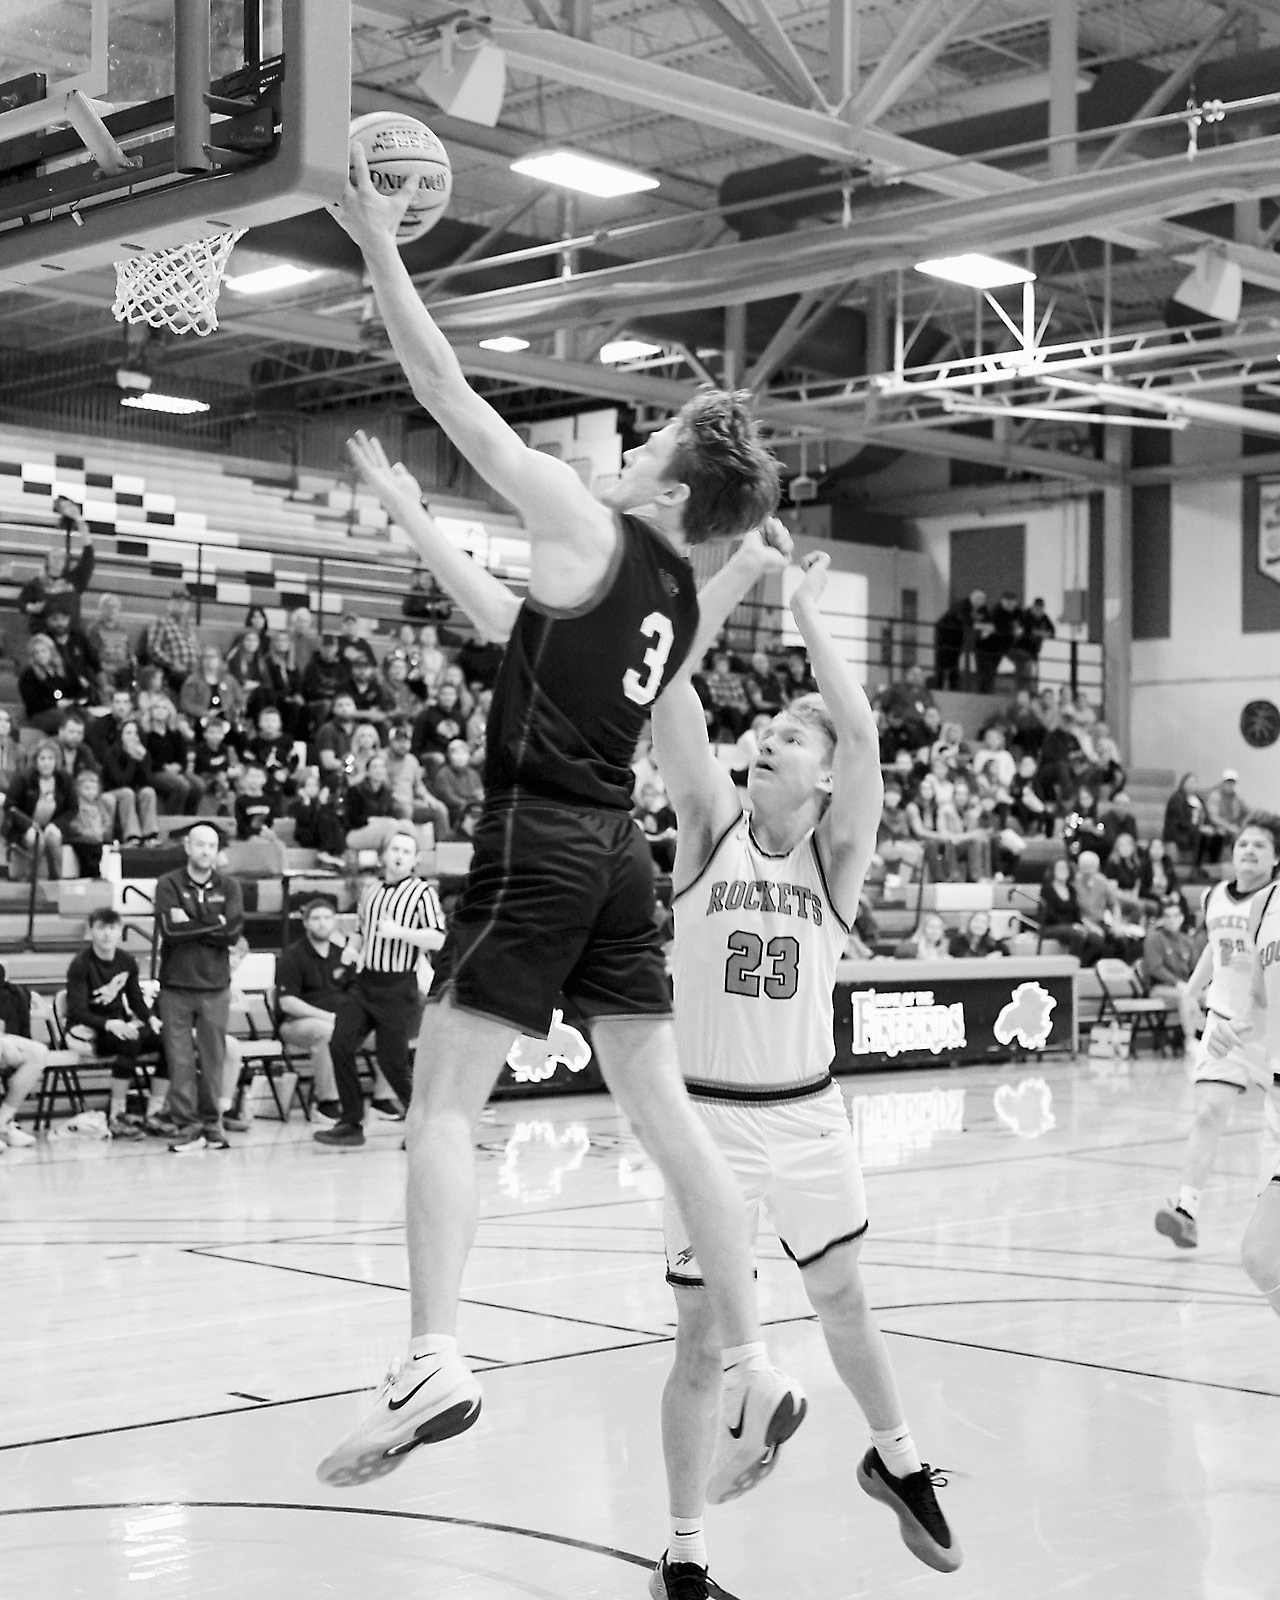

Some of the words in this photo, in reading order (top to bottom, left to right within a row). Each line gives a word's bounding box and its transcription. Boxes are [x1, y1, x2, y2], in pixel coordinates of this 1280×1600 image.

[622, 611, 675, 705] 3
[706, 880, 823, 926] ROCKETS
[725, 929, 800, 1000] 23
